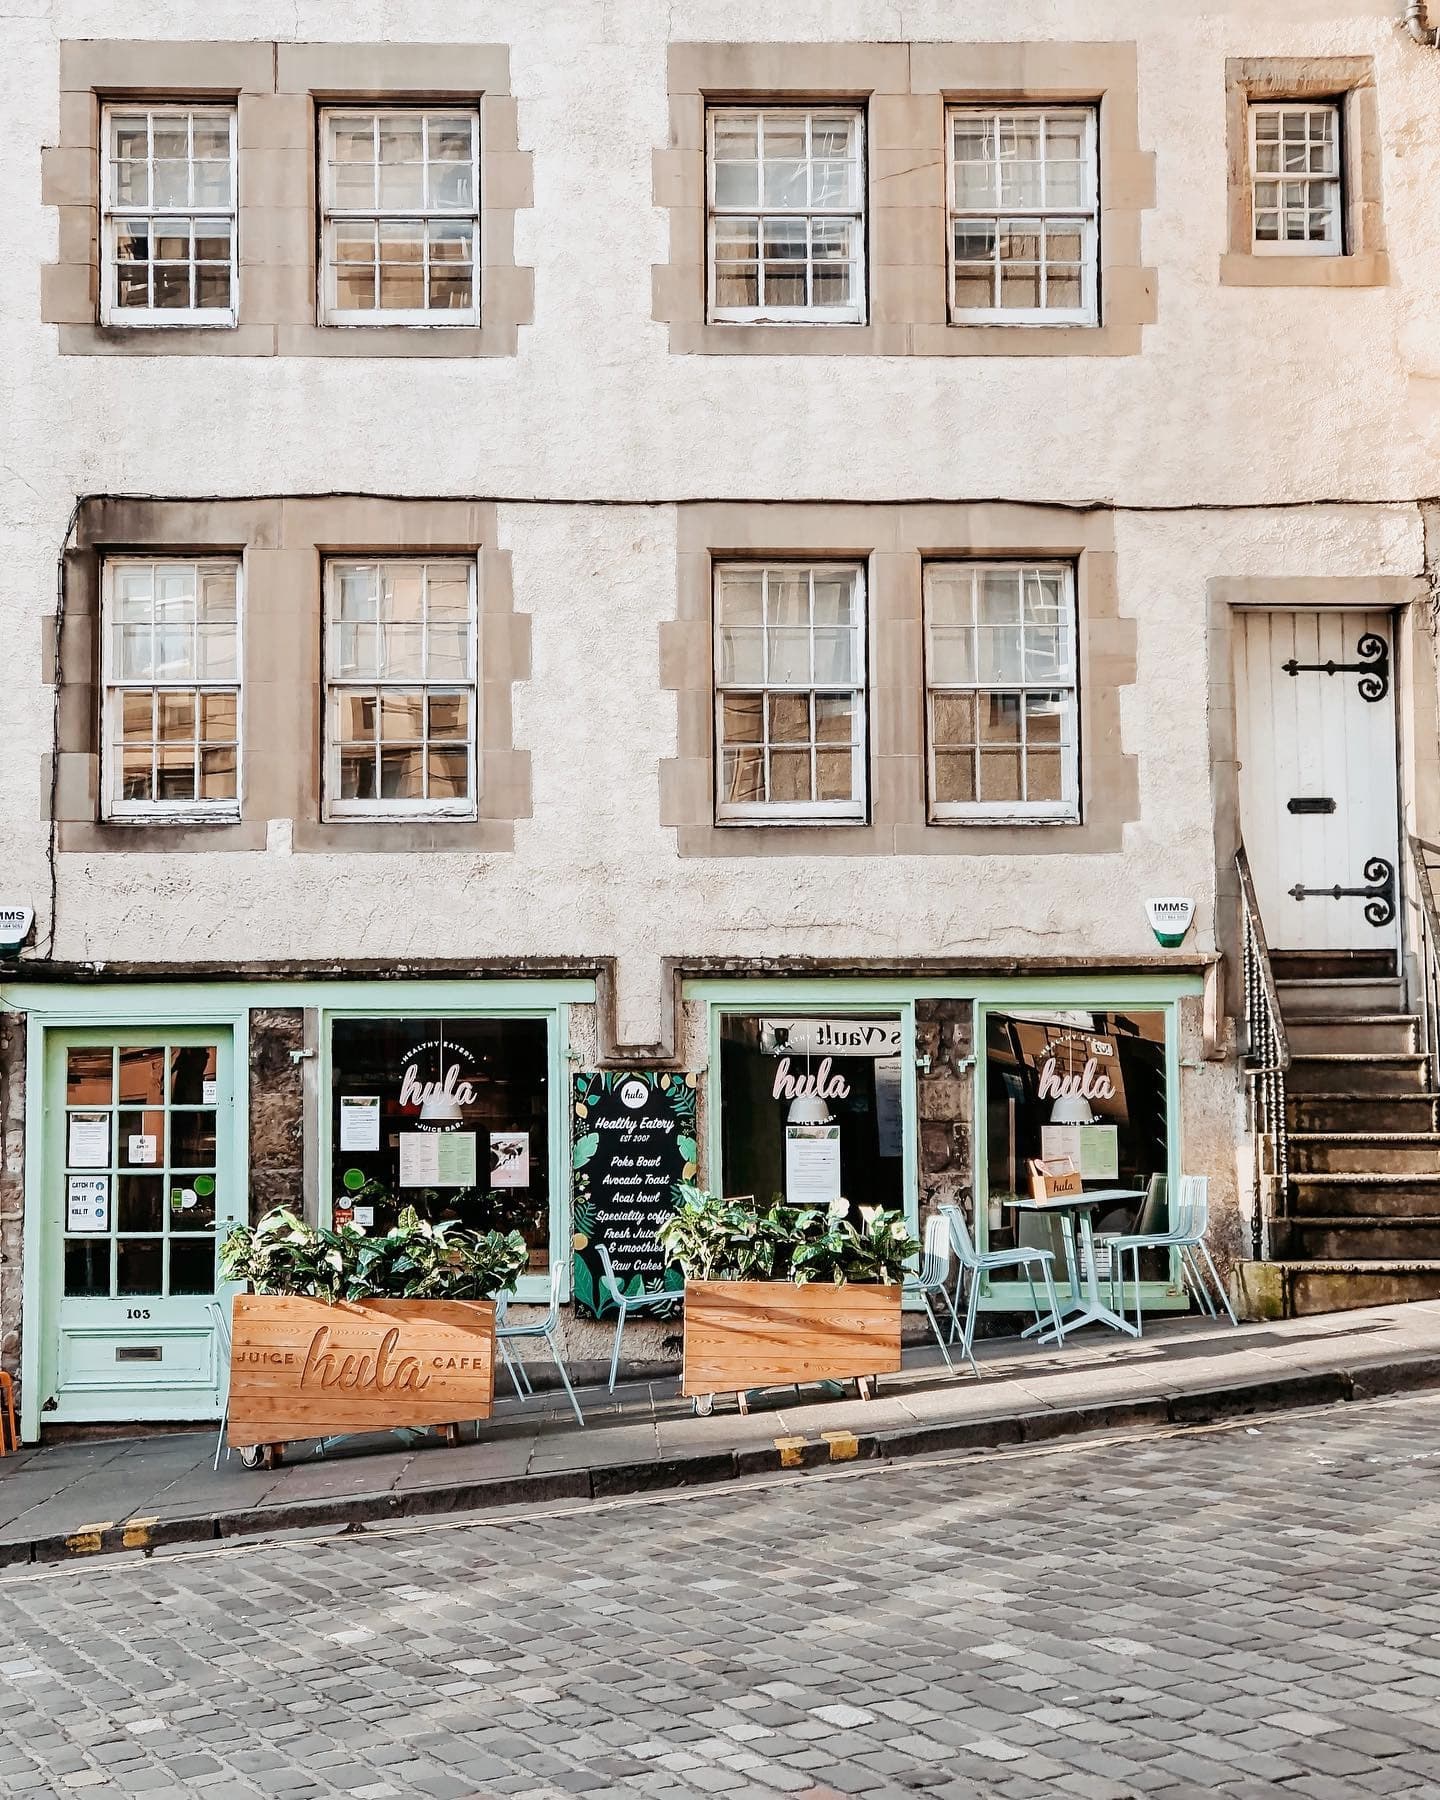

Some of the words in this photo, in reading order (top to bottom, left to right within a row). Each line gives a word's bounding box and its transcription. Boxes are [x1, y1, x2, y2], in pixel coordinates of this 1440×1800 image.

[1153, 902, 1189, 912] IMMS
[402, 1041, 440, 1062] HEALTHY
[443, 1041, 475, 1061] EATERY
[772, 1056, 851, 1100] hula
[1037, 1057, 1116, 1100] hula
[399, 1063, 478, 1107] hula
[624, 1088, 645, 1100] hula
[417, 1123, 442, 1133] JUICE
[445, 1121, 461, 1132] BAR
[595, 1116, 637, 1134] Healthy
[639, 1117, 675, 1134] Eatery
[619, 1134, 631, 1143] EST
[632, 1134, 651, 1143] 2007
[610, 1155, 634, 1167] Poke
[636, 1155, 662, 1167] Bowl
[602, 1173, 642, 1185] Avocado
[644, 1173, 670, 1185] Toast
[1053, 1178, 1074, 1193] hula
[612, 1192, 635, 1203] Acai
[636, 1191, 660, 1203] bowl
[595, 1209, 646, 1226] Speciality
[647, 1209, 676, 1225] coffee
[604, 1227, 631, 1239] Fresh
[608, 1241, 617, 1254] &
[617, 1241, 665, 1254] smoothies
[611, 1260, 632, 1271] Raw
[633, 1259, 663, 1271] Cakes
[126, 1308, 151, 1320] 103
[236, 1350, 295, 1366] JUICE
[300, 1324, 432, 1394] hula
[432, 1355, 483, 1371] CAFE
